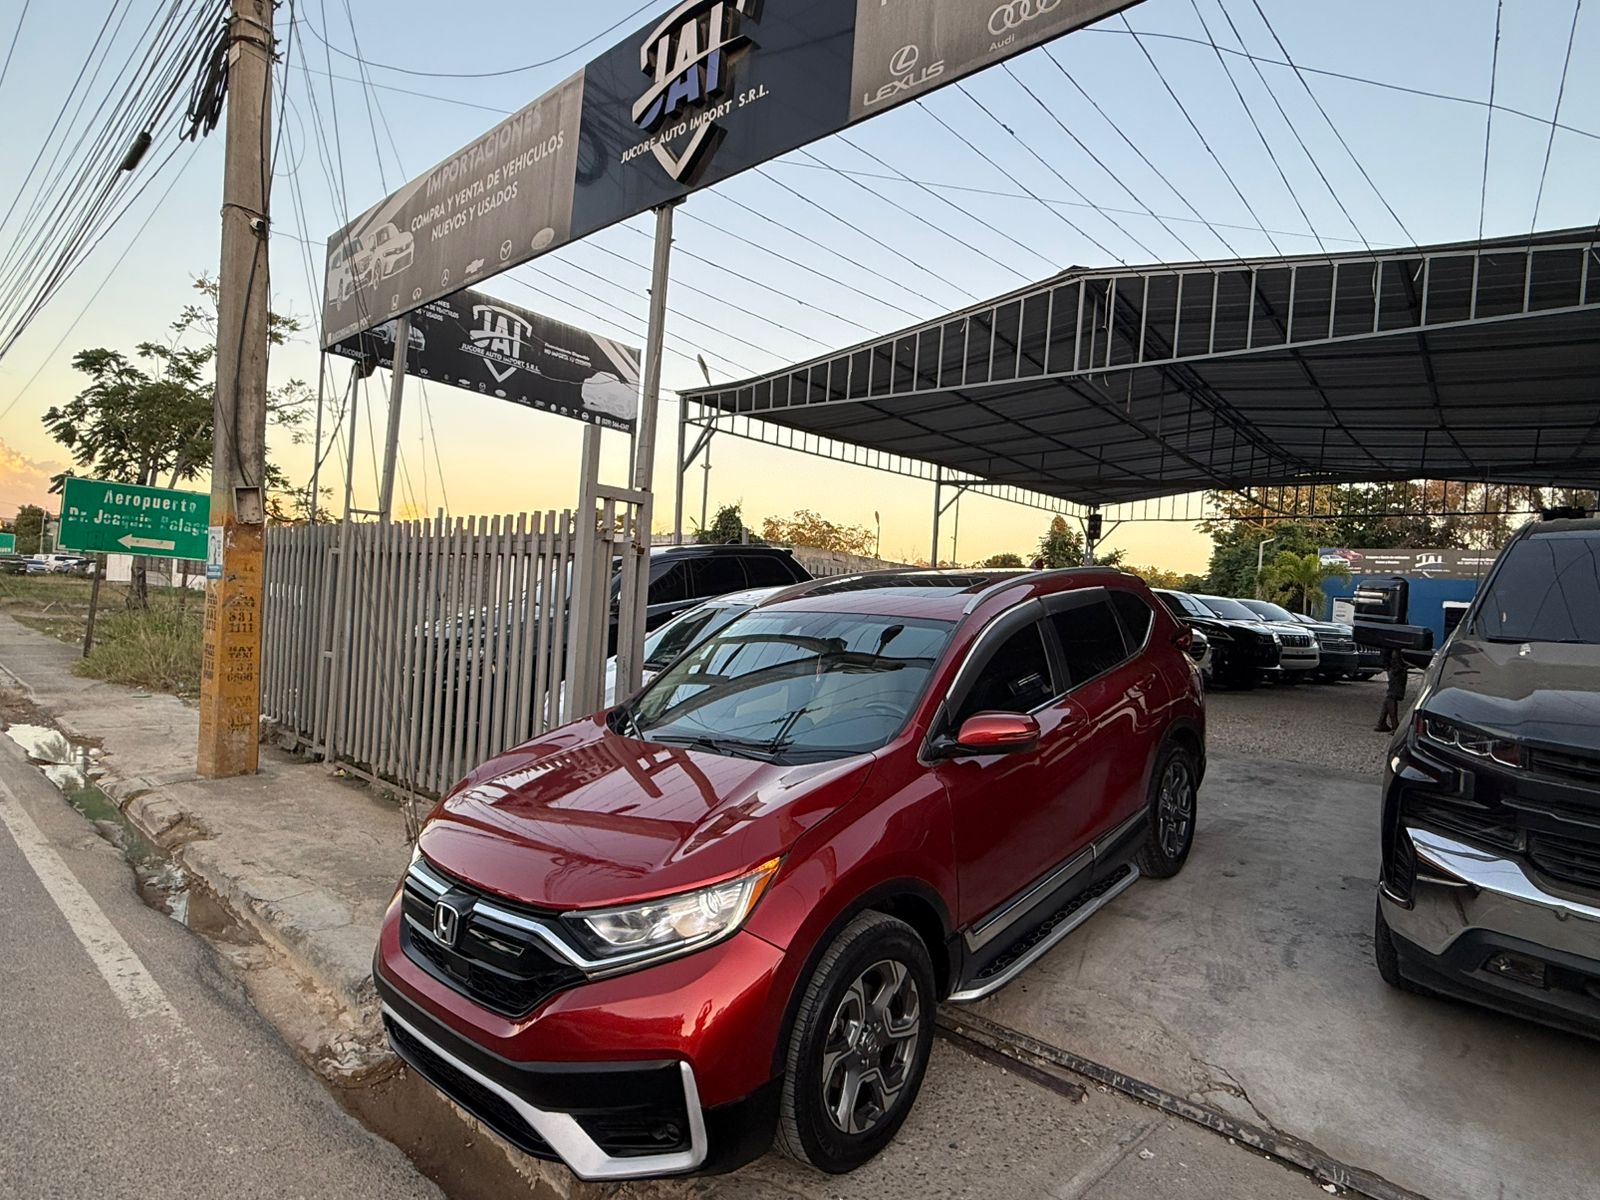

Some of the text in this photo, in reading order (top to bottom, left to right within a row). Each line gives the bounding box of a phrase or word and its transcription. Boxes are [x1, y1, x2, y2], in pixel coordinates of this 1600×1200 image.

[988, 33, 1015, 51] Audi
[863, 60, 945, 106] LEXUS
[426, 104, 543, 197] IMPORTACIONES
[620, 84, 769, 164] JUCORE AUTO IMPORT S.R.L.
[411, 131, 564, 232] COMPRA Y VENTA DE VEHICULOS
[431, 181, 518, 241] NUEVOS Y USADOS
[461, 343, 485, 355] JUCORE
[485, 351, 502, 360] AUTO
[103, 489, 197, 513] Aeropuerto
